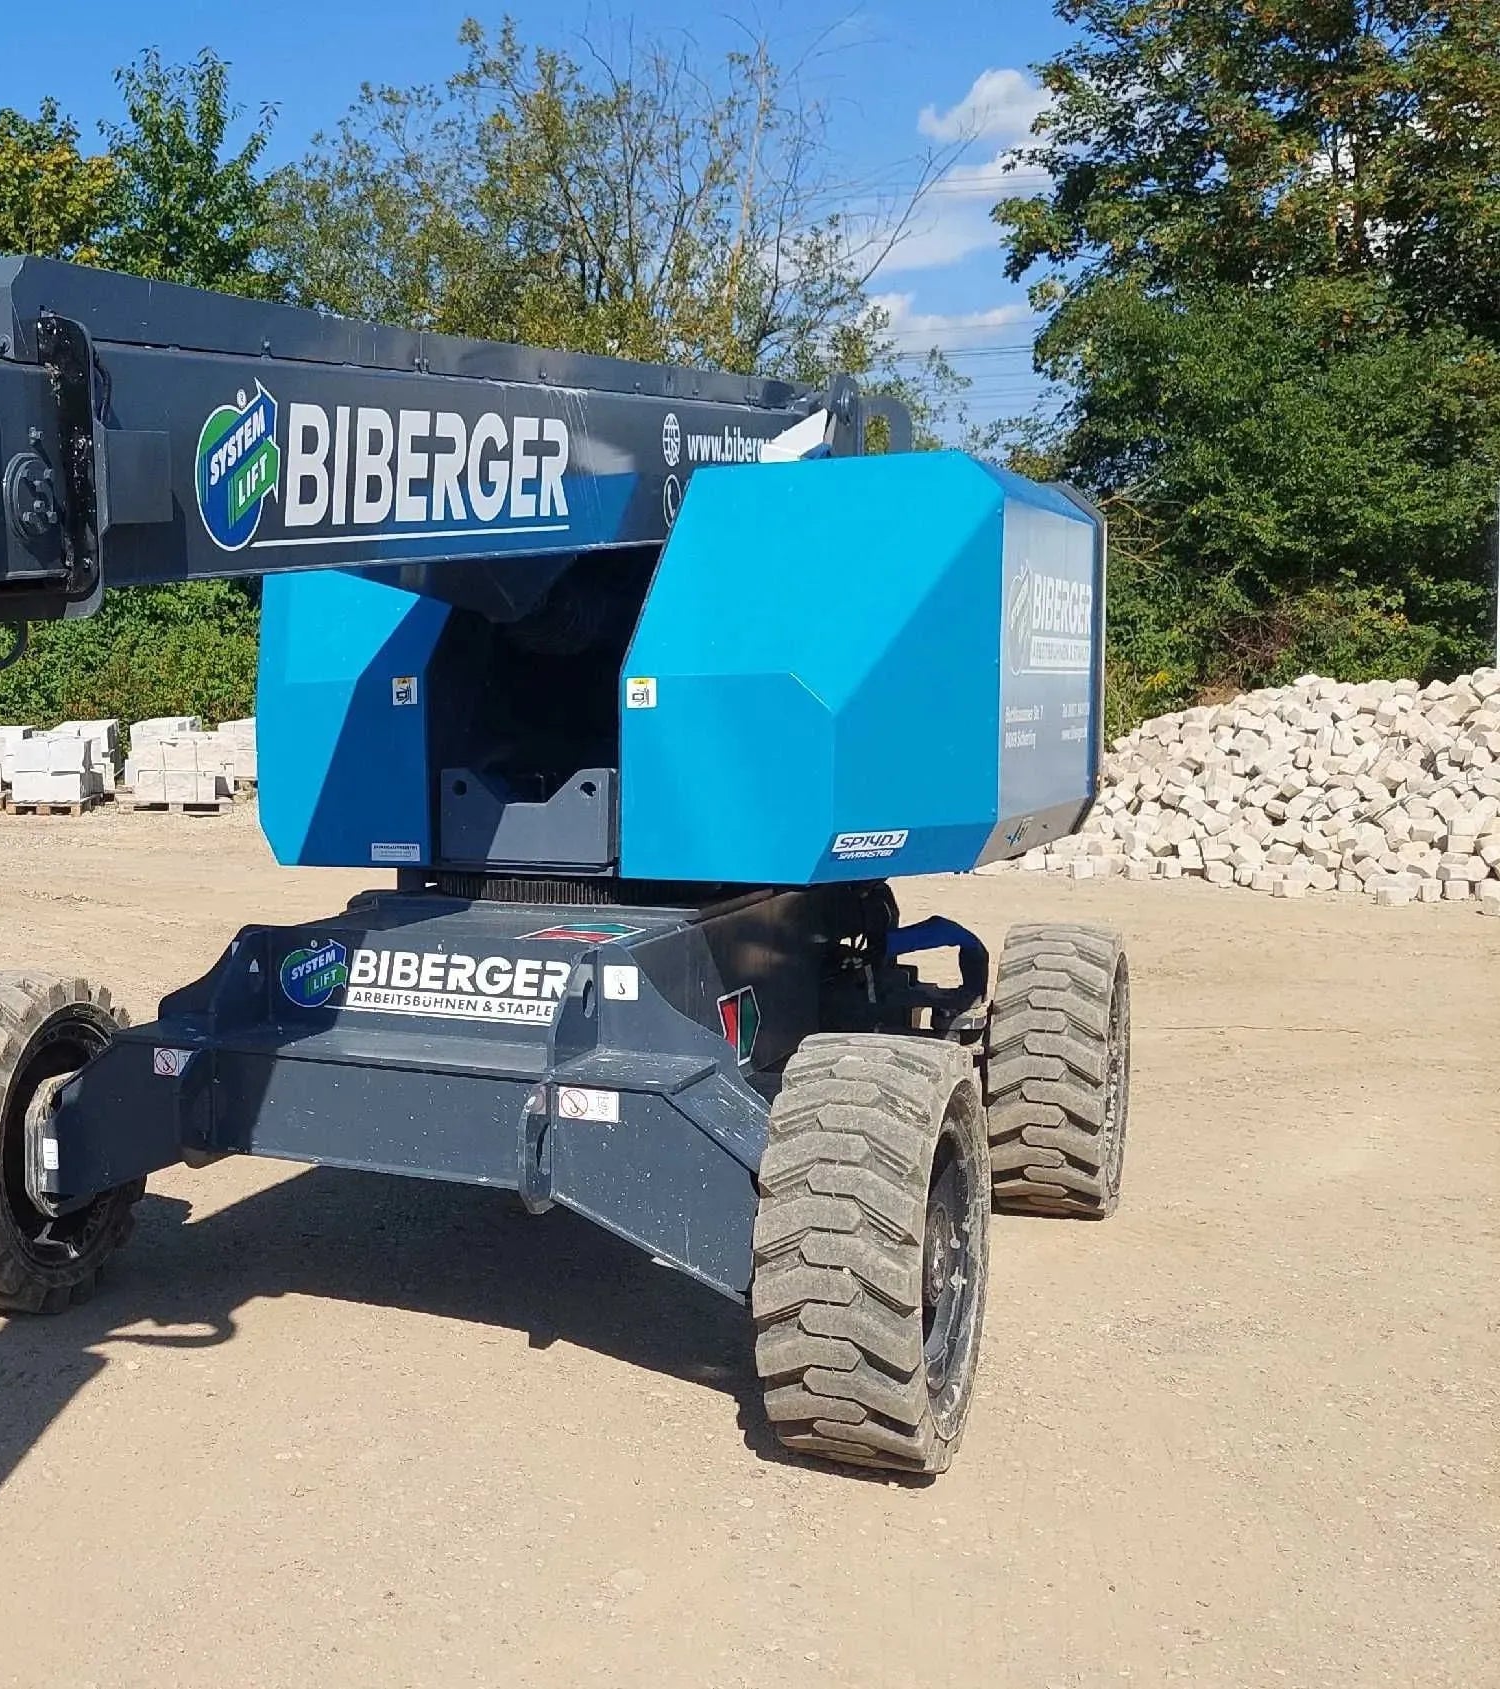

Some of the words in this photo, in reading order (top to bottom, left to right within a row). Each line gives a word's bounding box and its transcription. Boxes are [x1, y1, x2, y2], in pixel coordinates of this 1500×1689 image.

[209, 404, 266, 486] SYSTEM
[284, 402, 570, 528] BIBERGER
[237, 454, 269, 508] LIFT
[1032, 573, 1092, 635] BIBERGER
[836, 833, 905, 850] SP14DJ
[291, 949, 336, 980] SYSTEM
[313, 968, 338, 991] LIFT
[350, 949, 572, 1000] BIBERGER
[353, 990, 477, 1013] ARBEITSBÜHNEN
[482, 1001, 494, 1013] &
[497, 1001, 555, 1017] STAPLE
